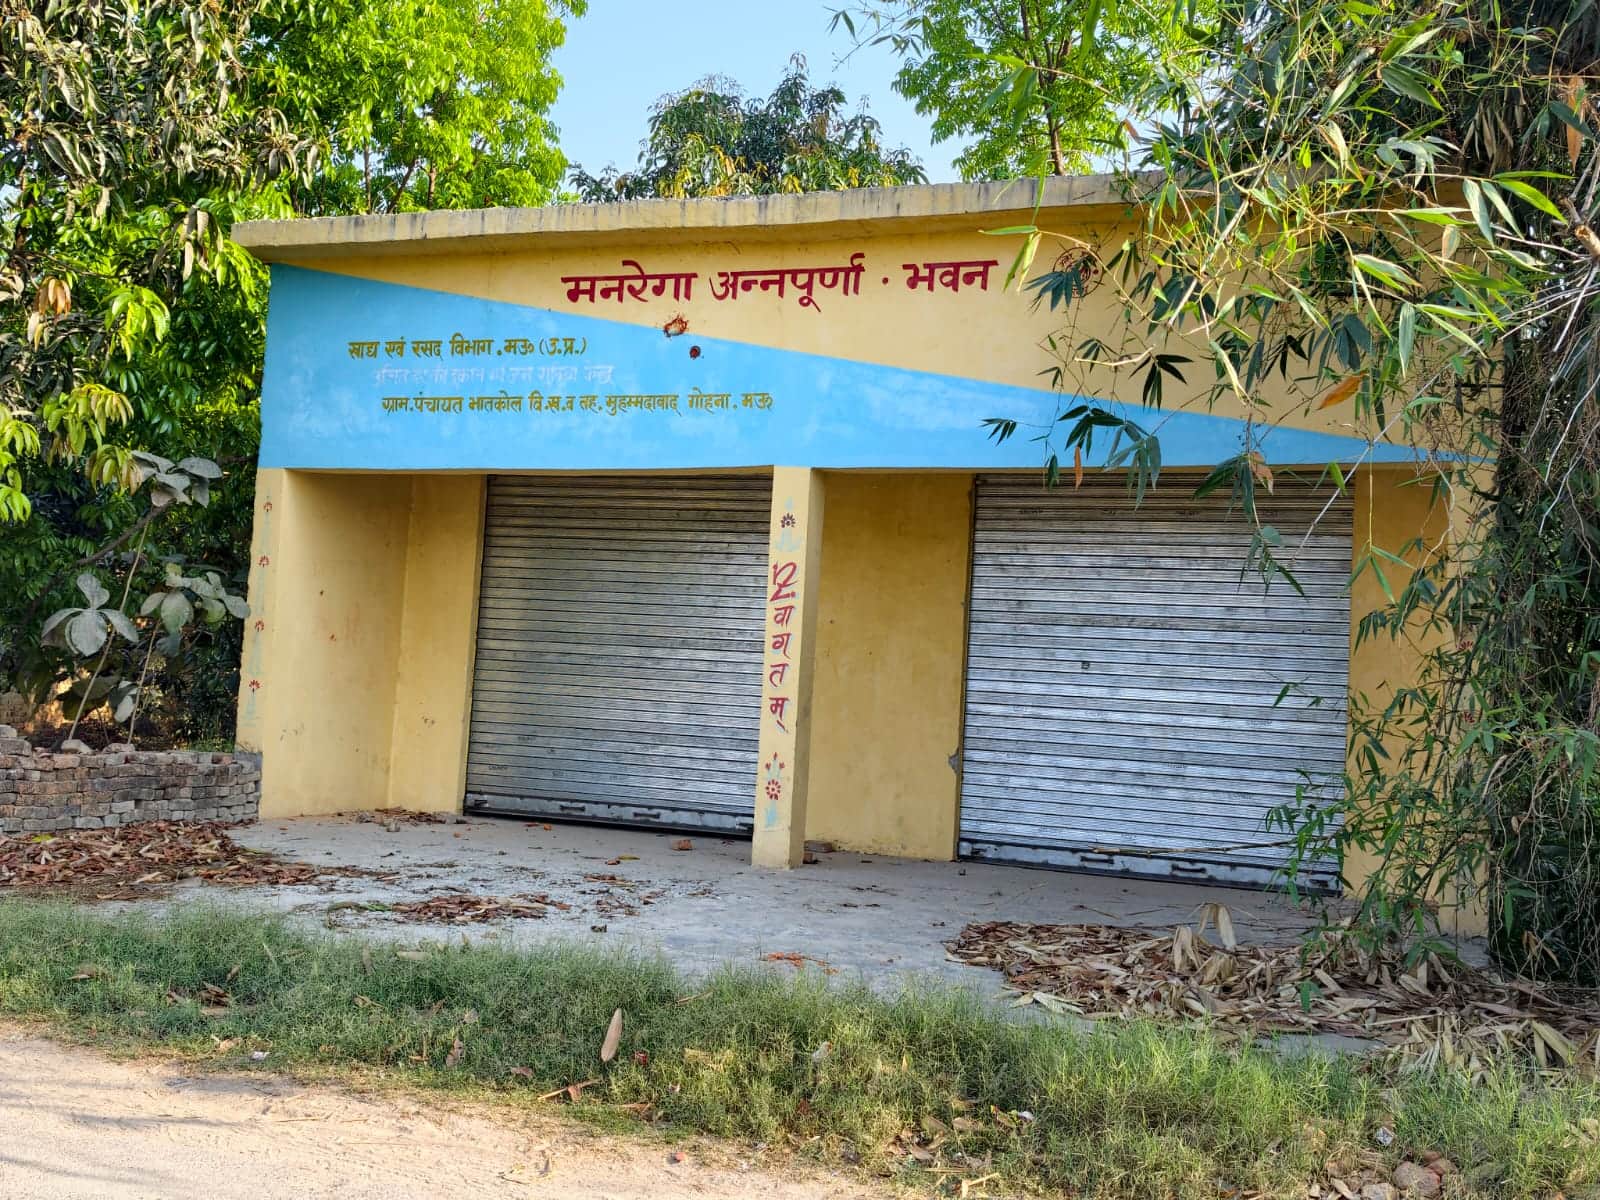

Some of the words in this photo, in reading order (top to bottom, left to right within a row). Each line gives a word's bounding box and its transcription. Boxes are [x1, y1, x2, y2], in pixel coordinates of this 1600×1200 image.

[561, 260, 698, 303] मनरेगा
[709, 252, 865, 312] अन्नपूर्णा
[902, 260, 999, 292] भवन
[449, 332, 494, 356] विभाग
